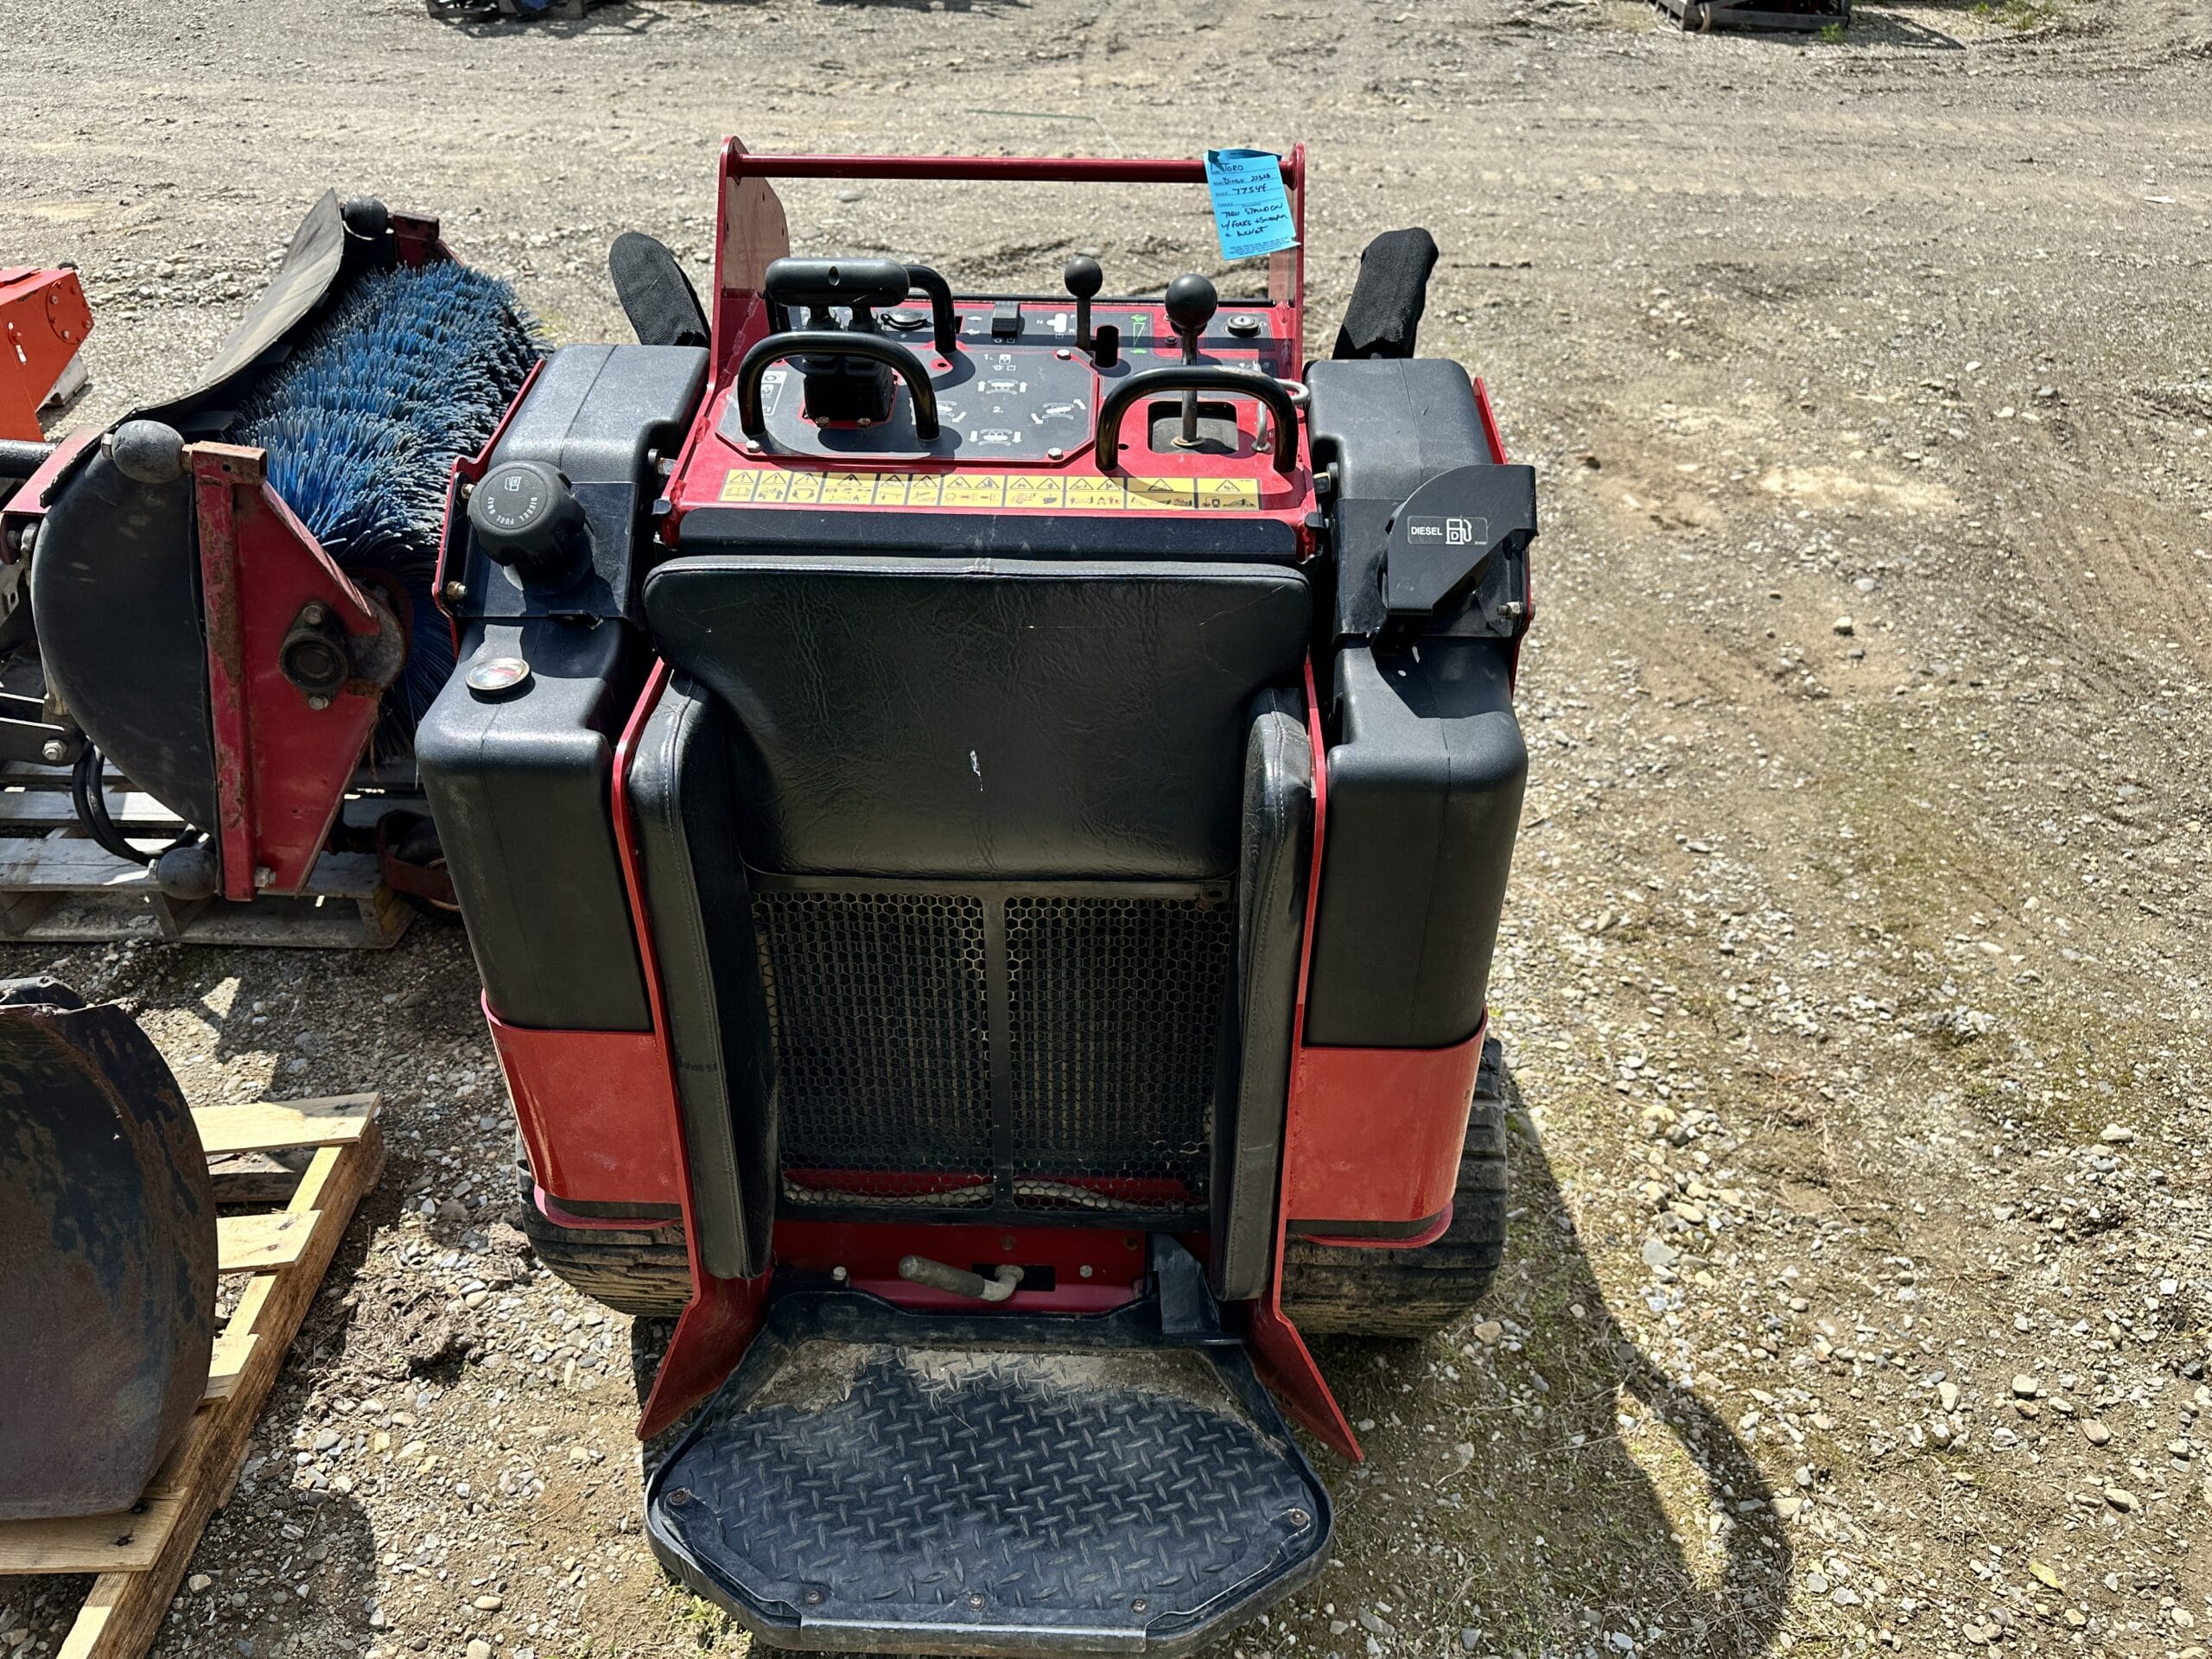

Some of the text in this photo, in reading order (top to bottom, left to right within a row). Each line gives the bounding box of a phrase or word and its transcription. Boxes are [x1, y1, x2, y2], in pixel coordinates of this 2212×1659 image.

[487, 496, 537, 524] DIESEL FUEL ONLY
[1411, 526, 1443, 536] DIESEL
[1451, 531, 1459, 540] D
